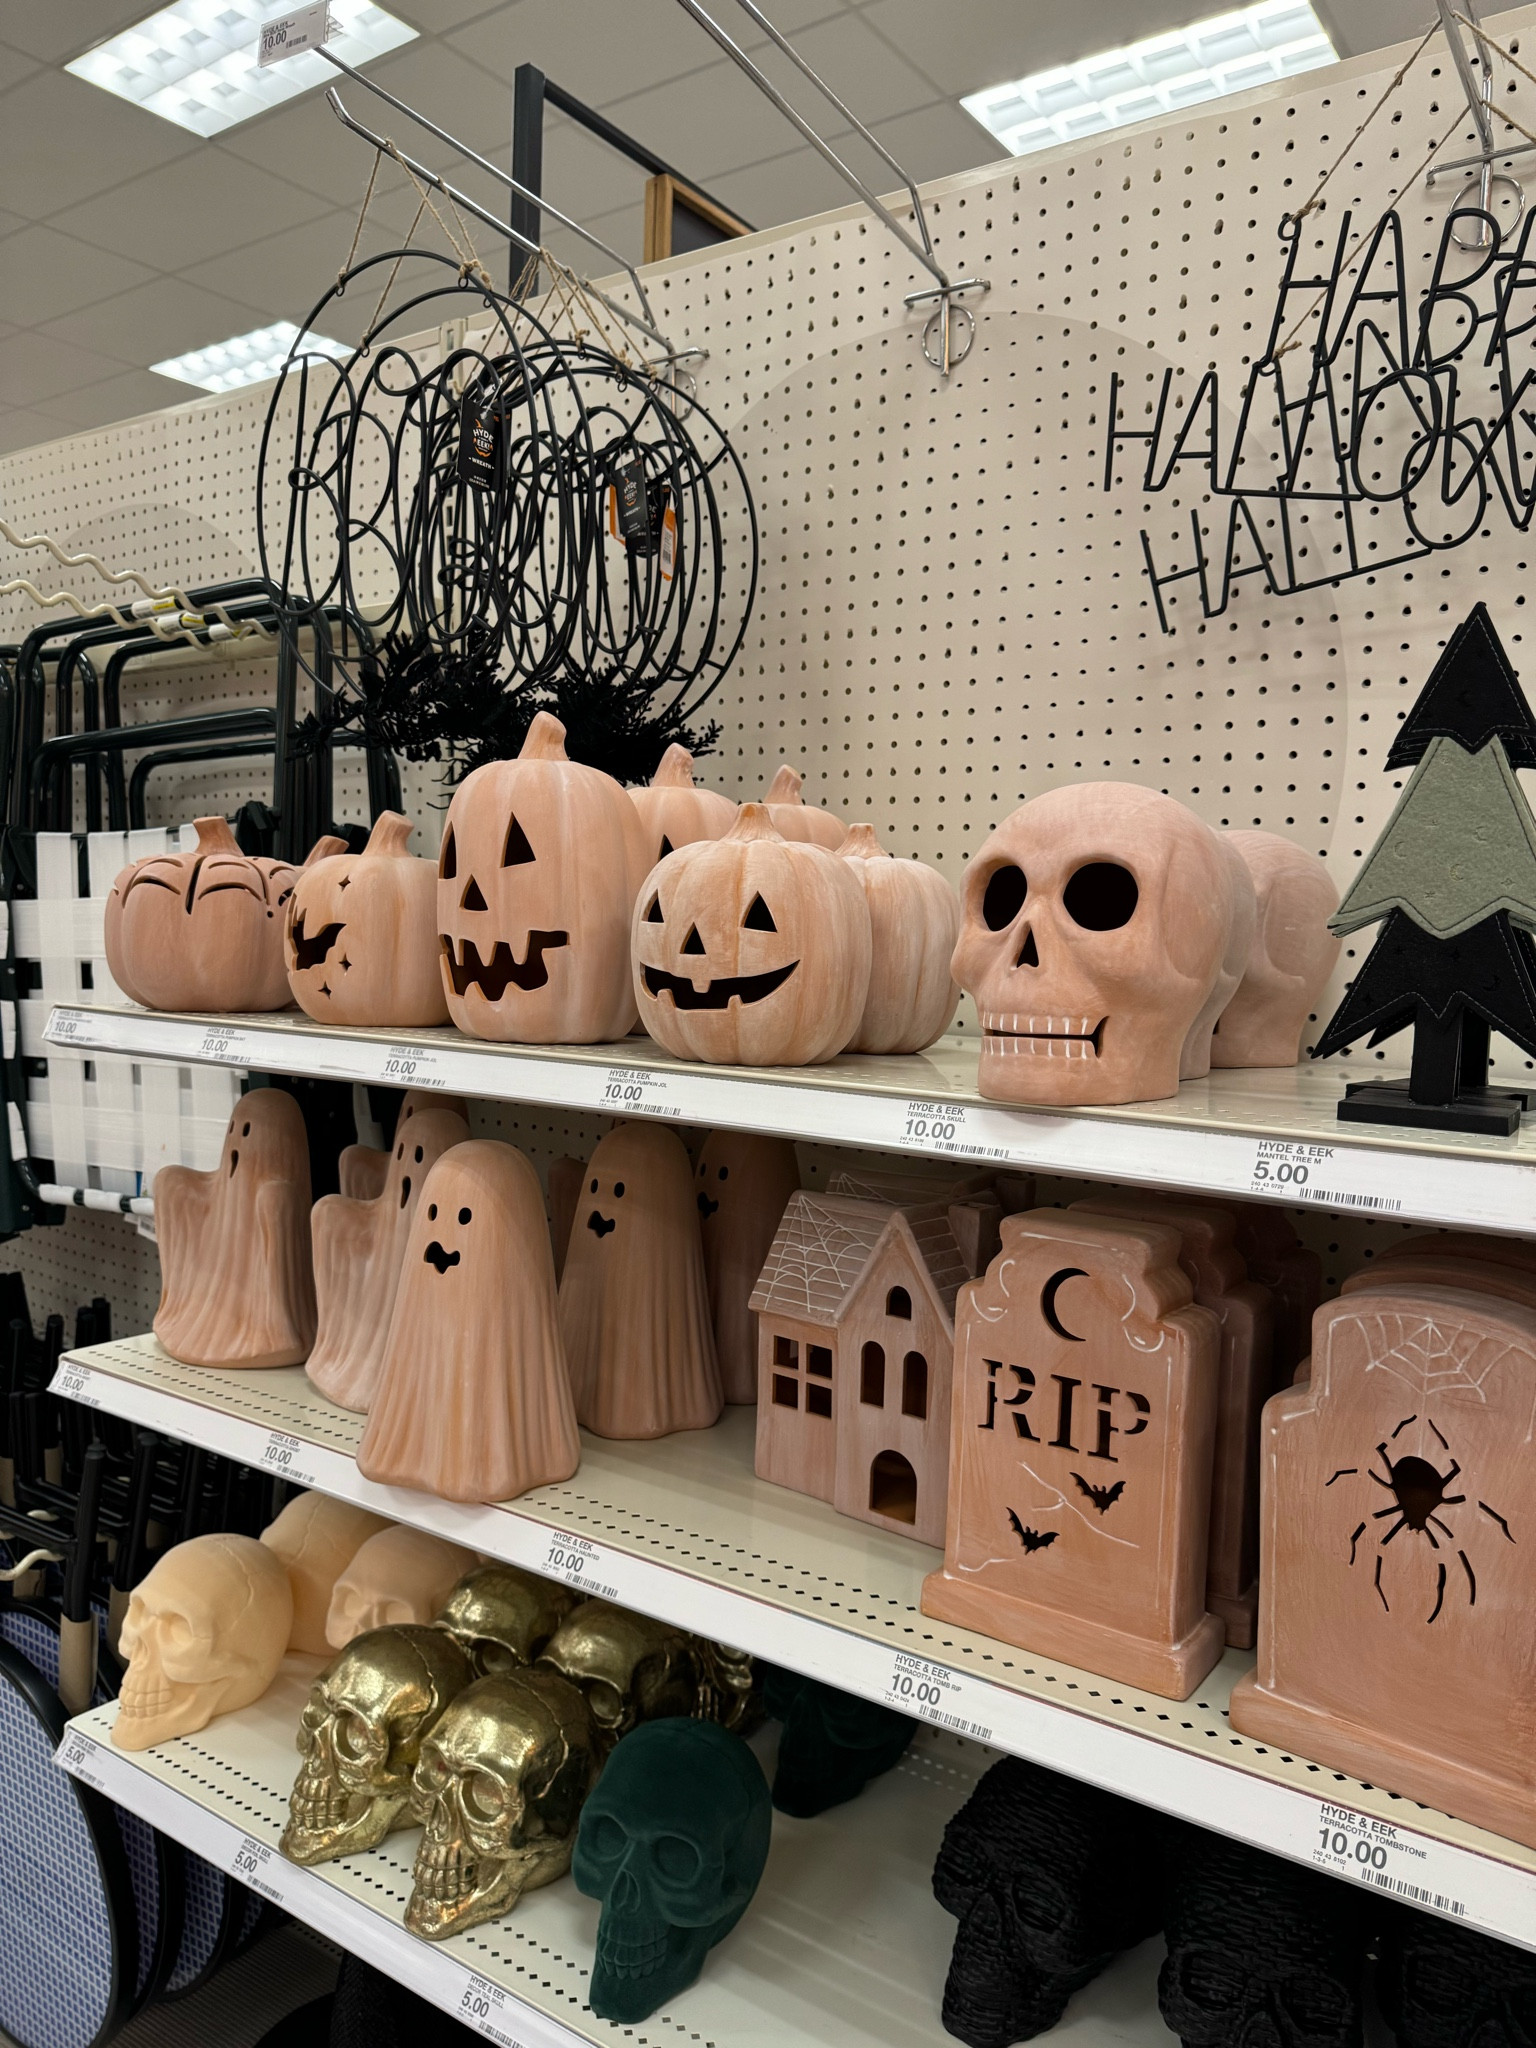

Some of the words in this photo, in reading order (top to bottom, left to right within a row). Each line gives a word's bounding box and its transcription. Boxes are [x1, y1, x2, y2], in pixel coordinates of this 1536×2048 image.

[263, 30, 287, 50] 10.00
[472, 428, 494, 443] HYDE
[55, 1021, 77, 1033] 10.00
[201, 1038, 229, 1052] 10.00
[412, 1048, 425, 1056] EEK
[385, 1059, 417, 1074] 10.00
[609, 1069, 629, 1078] HYDE
[636, 1072, 651, 1080] EEK
[605, 1083, 643, 1101] 10.00
[907, 1111, 946, 1121] TERRACOTTA
[946, 1115, 967, 1123] SKULL
[908, 1102, 935, 1112] HYDE
[936, 1105, 943, 1114] &
[945, 1106, 965, 1116] EEK
[905, 1119, 956, 1140] 10.00
[1256, 1151, 1290, 1161] MANTEL
[1292, 1155, 1312, 1164] TREE
[1258, 1141, 1294, 1154] HYDE
[1296, 1145, 1305, 1155] &
[1308, 1146, 1335, 1158] EEK
[1253, 1160, 1309, 1185] 5.00
[62, 1376, 84, 1391] 10.00
[977, 1358, 1151, 1463] RIP
[265, 1445, 292, 1465] 10.00
[551, 1540, 579, 1553] TERRACOTTA
[553, 1531, 572, 1544] HYDE
[572, 1538, 578, 1546] &
[578, 1540, 594, 1551] EEK
[548, 1547, 584, 1573] 10.00
[895, 1653, 922, 1671] HYDE
[922, 1663, 929, 1673] &
[931, 1666, 951, 1681] EEK
[894, 1663, 932, 1682] TERRACOTTA
[932, 1677, 951, 1689] TOMB
[951, 1684, 962, 1692] RIP
[892, 1673, 941, 1706] 10.00
[66, 1746, 85, 1764] 5.00
[1320, 1803, 1357, 1825] HYDE
[1358, 1817, 1368, 1829] &
[1371, 1821, 1398, 1840] EEK
[1319, 1815, 1373, 1841] TERRACOTTA
[1374, 1834, 1428, 1860] TOMBSTONE
[1319, 1827, 1388, 1870] 10.00
[235, 1851, 258, 1873] 5.00
[470, 1975, 489, 1991] HYDE
[493, 1989, 506, 2002] EEK
[462, 1990, 490, 2018] 5.00
